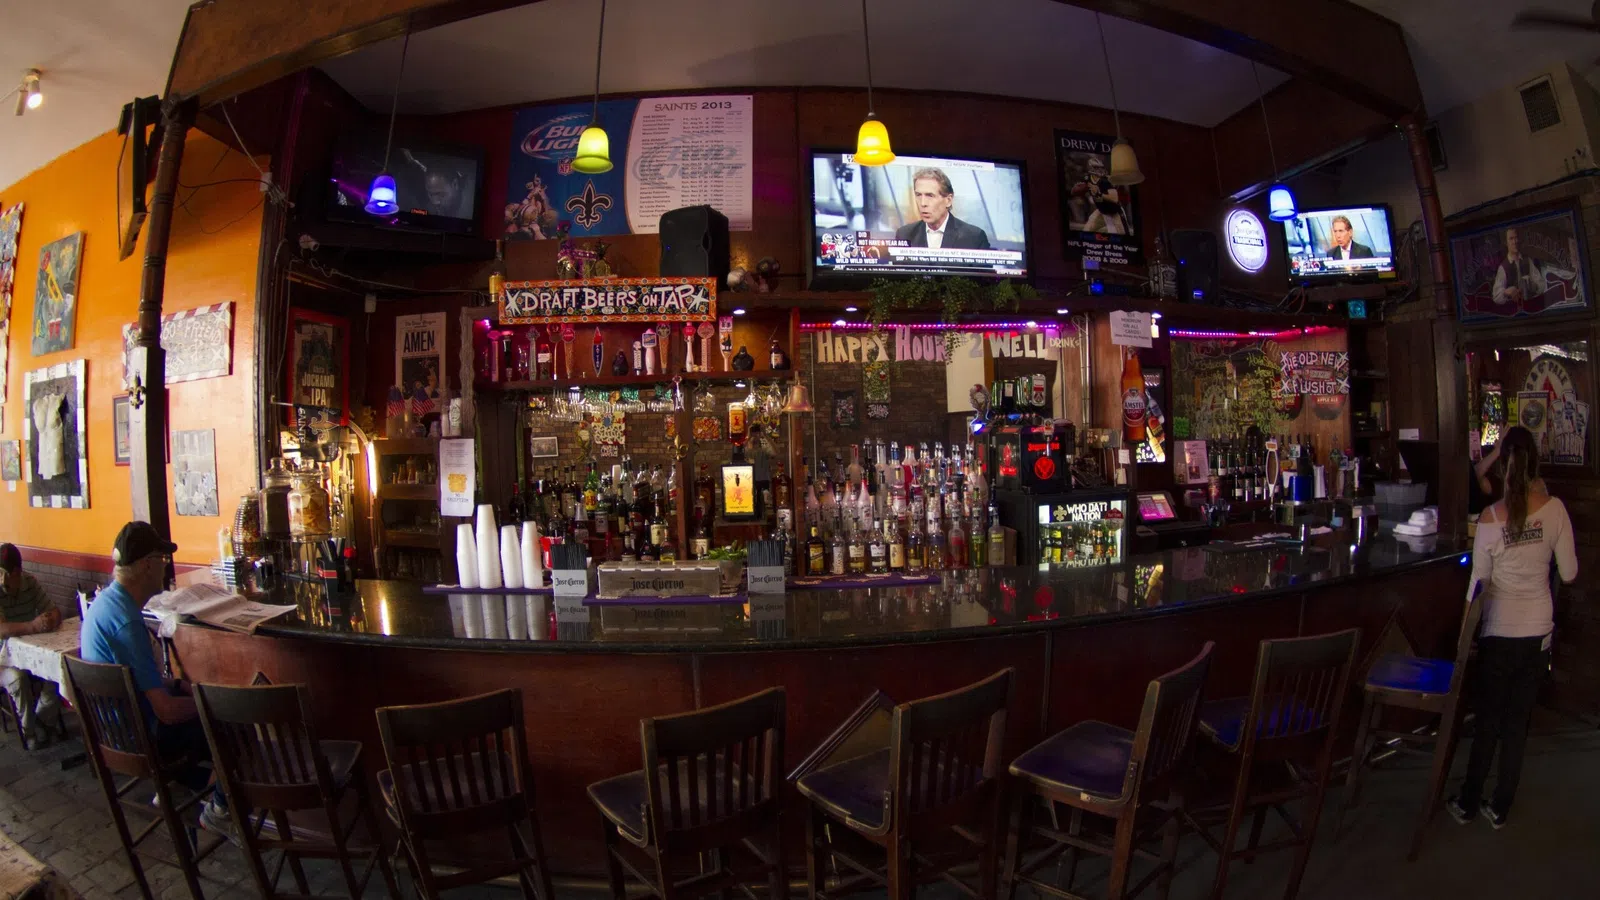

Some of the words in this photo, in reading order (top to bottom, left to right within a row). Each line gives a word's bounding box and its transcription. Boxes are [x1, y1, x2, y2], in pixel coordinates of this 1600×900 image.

[654, 102, 698, 112] SAINTS
[701, 101, 732, 110] 2013
[1061, 137, 1098, 151] DREW
[1067, 240, 1081, 248] NFL
[1083, 241, 1103, 250] Player
[1124, 245, 1139, 253] Year
[1104, 250, 1123, 258] Brees
[1109, 257, 1129, 265] 2009
[521, 287, 580, 312] DRAFT
[581, 287, 637, 310] BEERS
[652, 284, 695, 309] TAP
[403, 329, 435, 353] AMEN
[816, 329, 890, 363] HAPPY
[988, 330, 1049, 359] WELL
[1299, 351, 1318, 366] OLD
[311, 387, 327, 406] IPA
[1124, 401, 1144, 409] AMSTEL
[1066, 503, 1087, 514] WHO
[1088, 501, 1108, 512] DAT?
[1071, 511, 1101, 522] NATION
[555, 577, 567, 587] Jose
[567, 577, 585, 586] Cuervo
[630, 576, 652, 592] Jose
[652, 576, 685, 592] Cuervo
[750, 574, 763, 584] Jose
[763, 574, 783, 584] Cuervo
